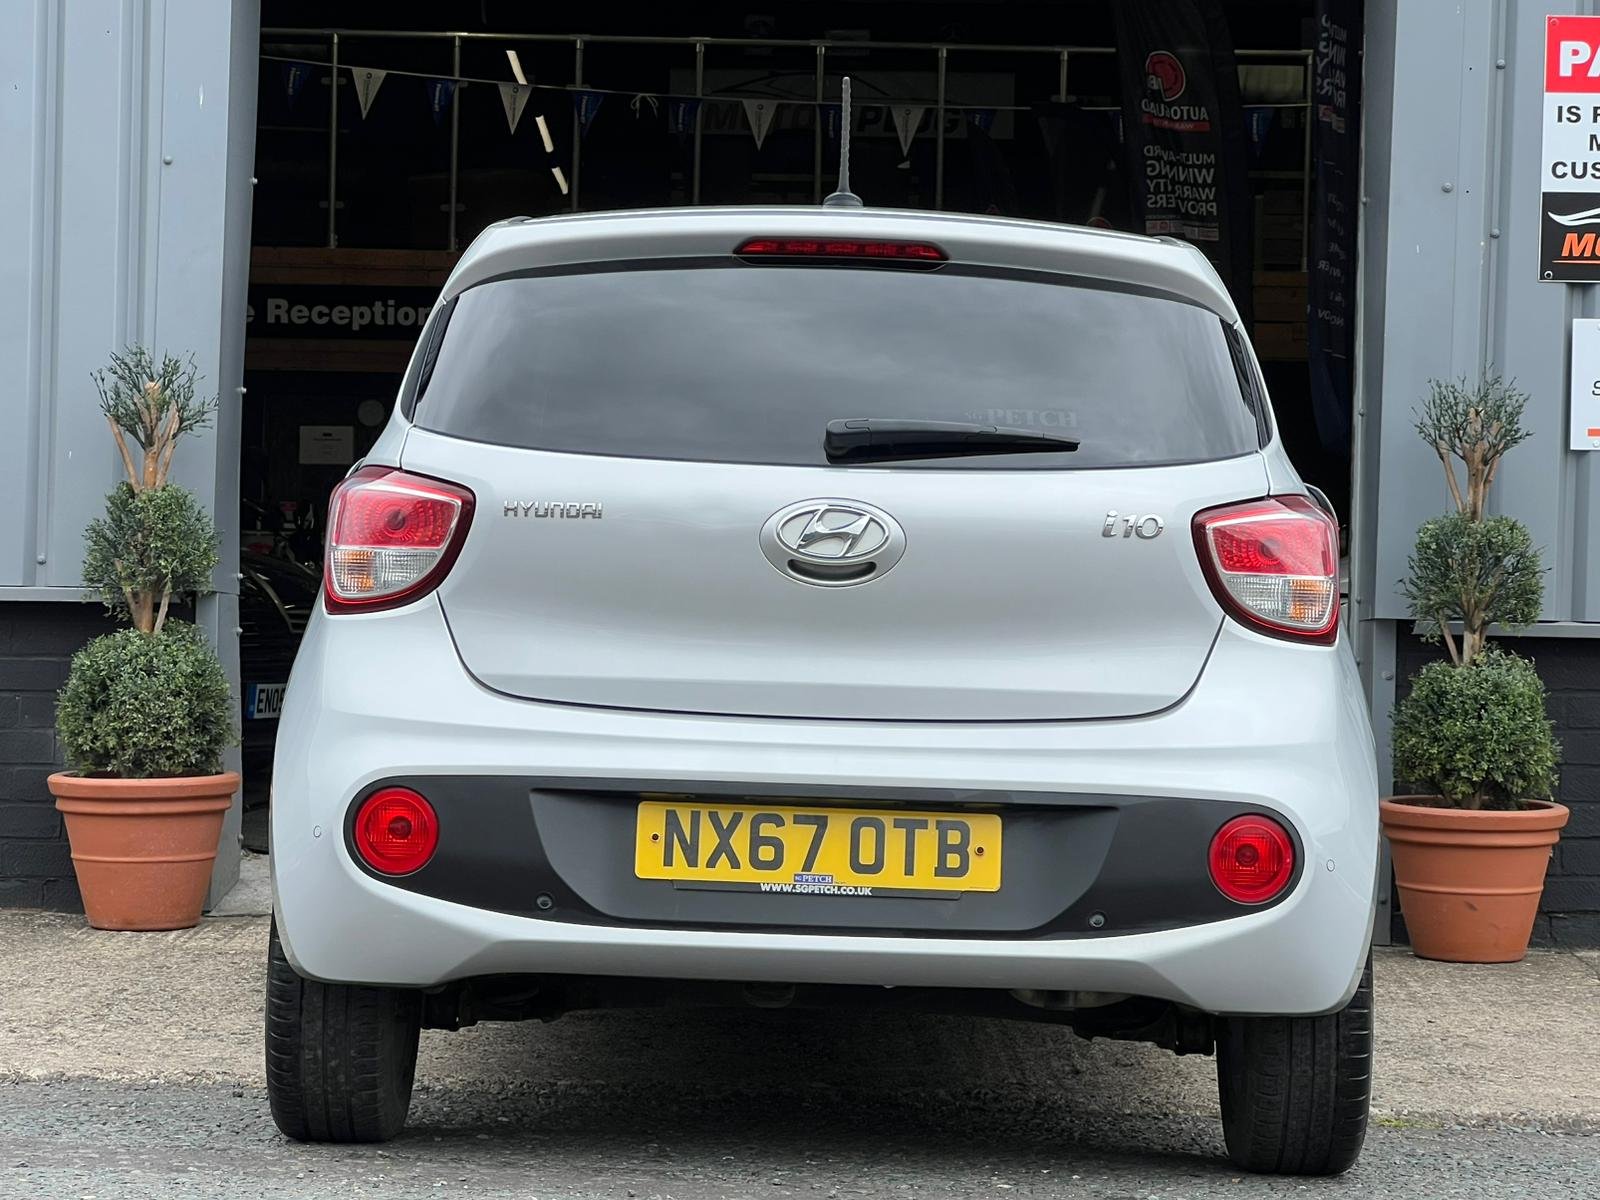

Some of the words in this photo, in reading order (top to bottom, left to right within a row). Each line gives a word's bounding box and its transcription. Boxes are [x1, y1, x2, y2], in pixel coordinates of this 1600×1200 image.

[1557, 105, 1581, 123] IS
[984, 408, 1078, 427] PETCH
[503, 500, 602, 519] HYUNDAI
[1102, 510, 1164, 539] i10
[663, 809, 829, 873] NX67
[850, 816, 970, 878] OTB
[802, 874, 832, 883] PETCH
[760, 883, 872, 896] WWW.SGPETCH.CO.UK
